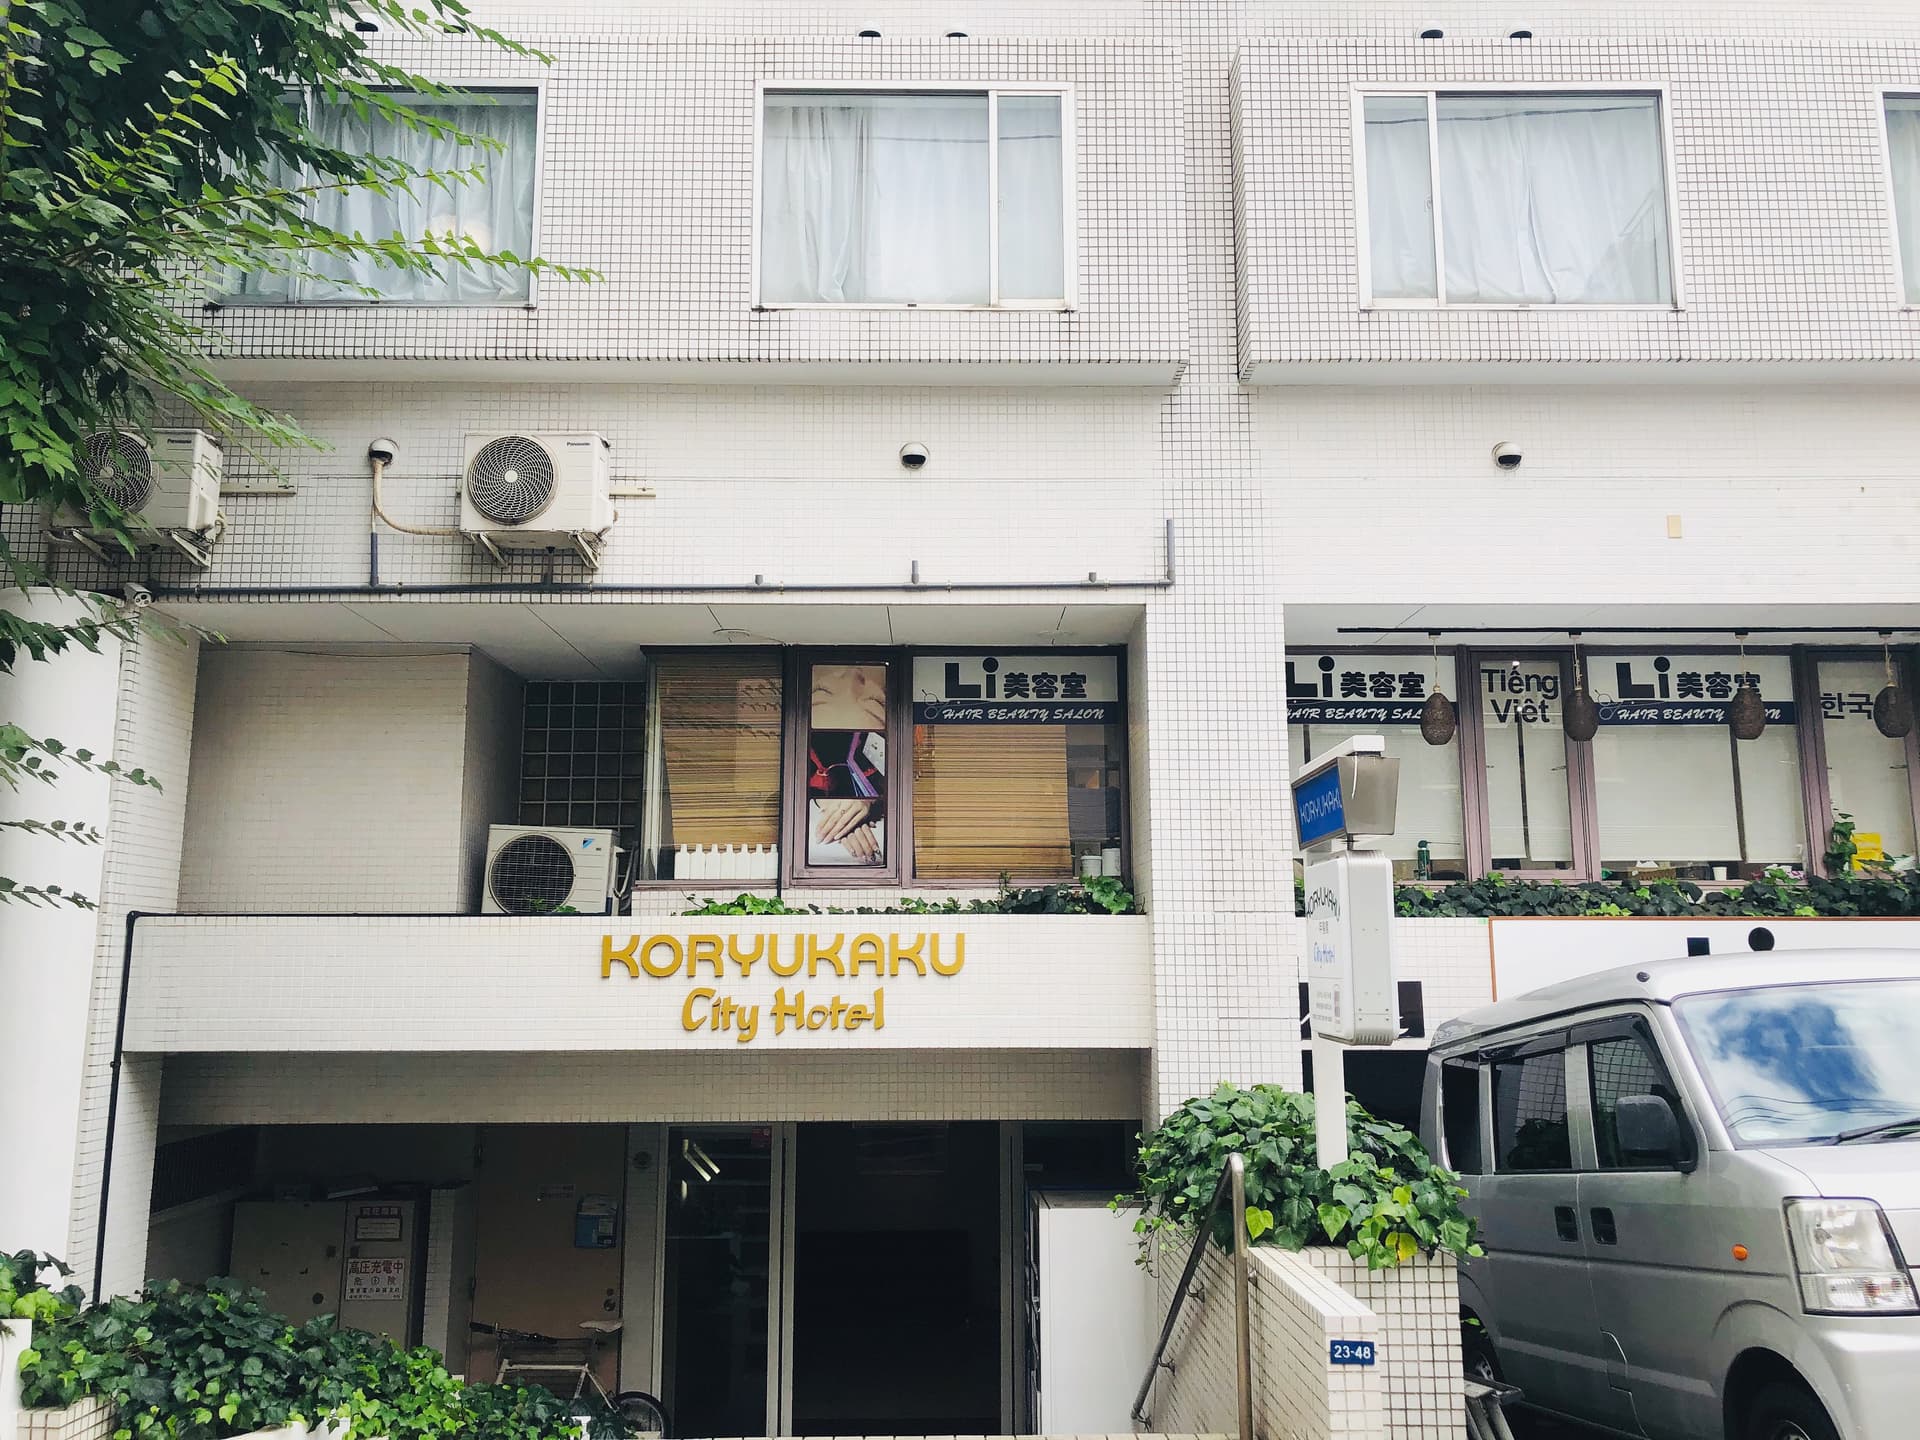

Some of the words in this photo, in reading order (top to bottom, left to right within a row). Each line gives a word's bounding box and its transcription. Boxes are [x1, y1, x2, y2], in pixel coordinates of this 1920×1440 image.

[945, 657, 998, 698] Li
[1004, 672, 1087, 699] 美容室
[1286, 656, 1335, 697] Li
[1340, 671, 1425, 698] 美容室
[1481, 665, 1558, 700] Tiếng
[1616, 656, 1670, 699] Li
[942, 708, 983, 720] HAIR
[988, 708, 1049, 722] BEAUTY
[1053, 708, 1105, 720] SALON
[1325, 708, 1387, 722] BEAUTY
[1391, 708, 1423, 720] SAL
[1617, 708, 1658, 720] HAIR
[1663, 708, 1725, 722] BEAUTY
[1820, 692, 1874, 720] 한국
[601, 933, 965, 978] KORYUKAKU
[682, 987, 759, 1042] City
[770, 986, 884, 1036] Hotel
[1334, 1345, 1371, 1359] 23-48
